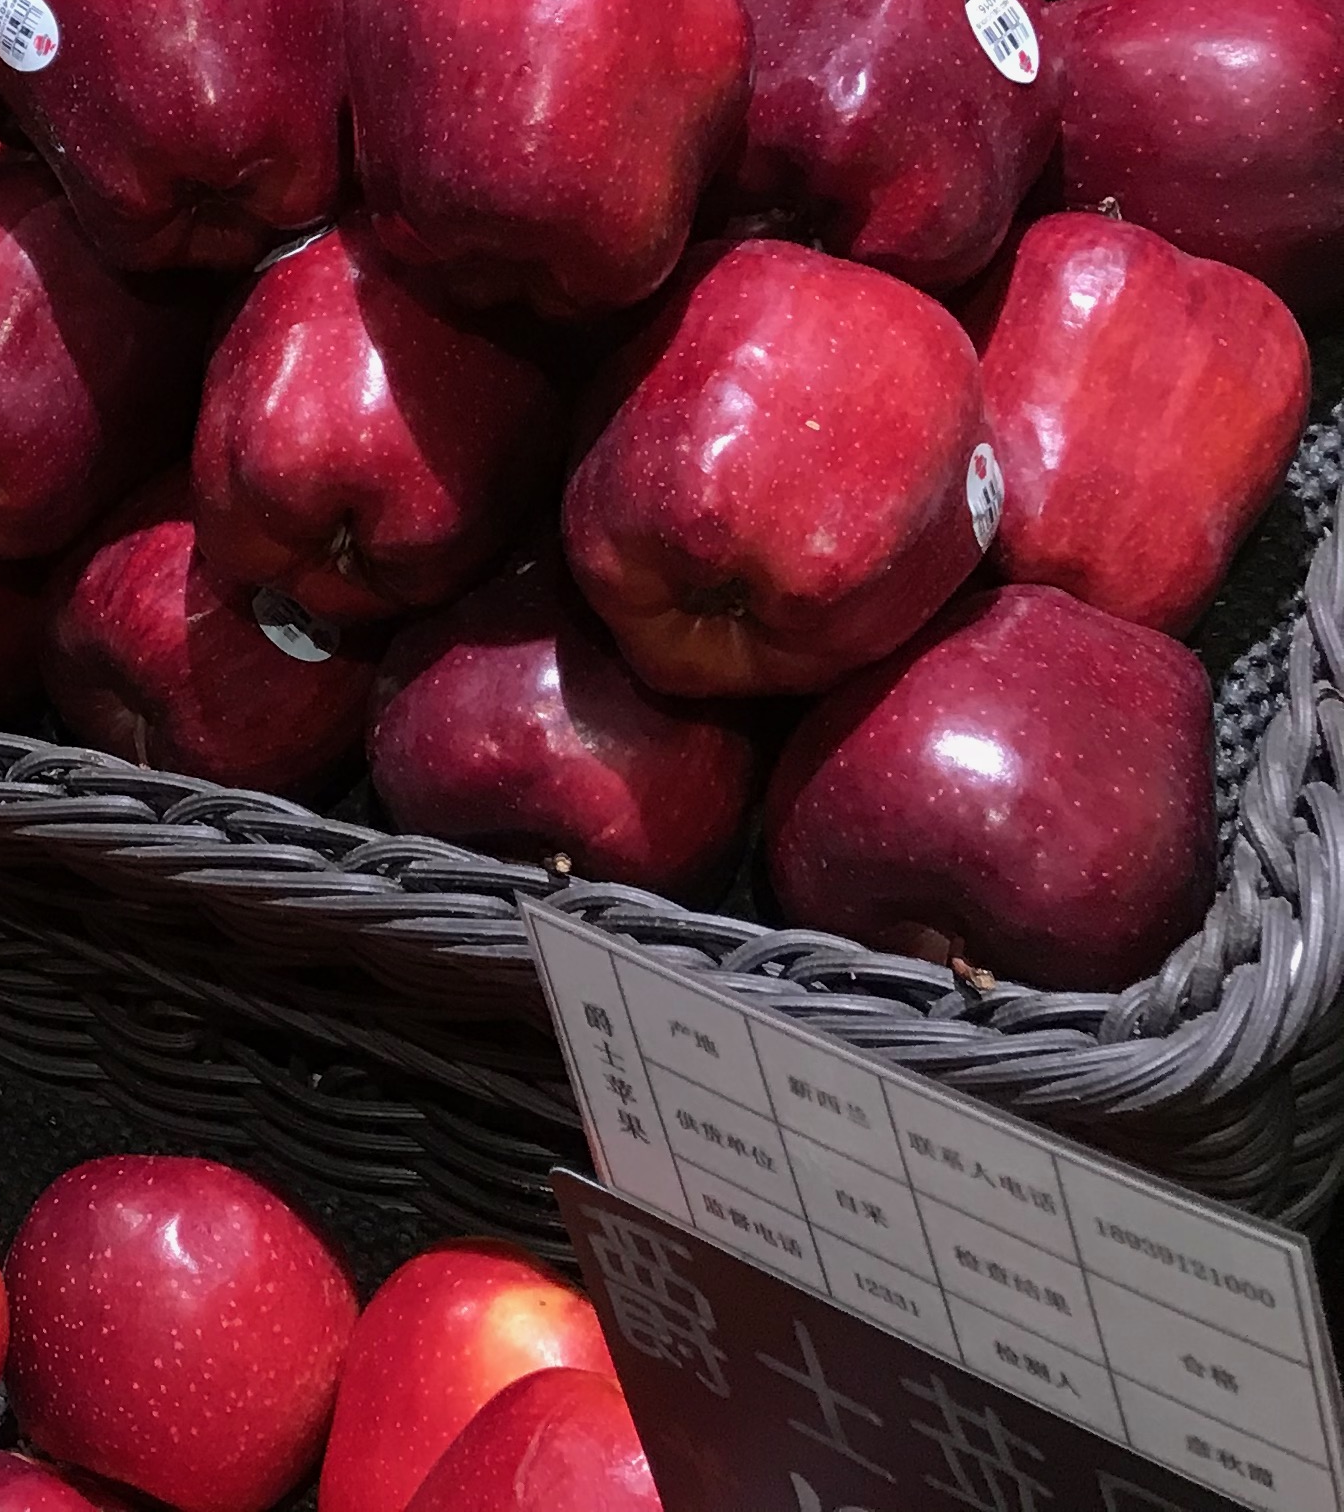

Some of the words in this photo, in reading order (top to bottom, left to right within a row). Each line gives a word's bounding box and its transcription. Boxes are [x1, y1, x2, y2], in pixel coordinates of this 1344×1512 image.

[581, 1000, 651, 1145] 爵士苹果
[668, 1019, 721, 1059] 产地
[786, 1074, 871, 1130] 新西兰
[906, 1130, 1058, 1216] 联系人电话
[674, 1107, 777, 1174] 供货单位
[952, 1244, 1073, 1318] 检查结果
[701, 1192, 804, 1260] 监督电话
